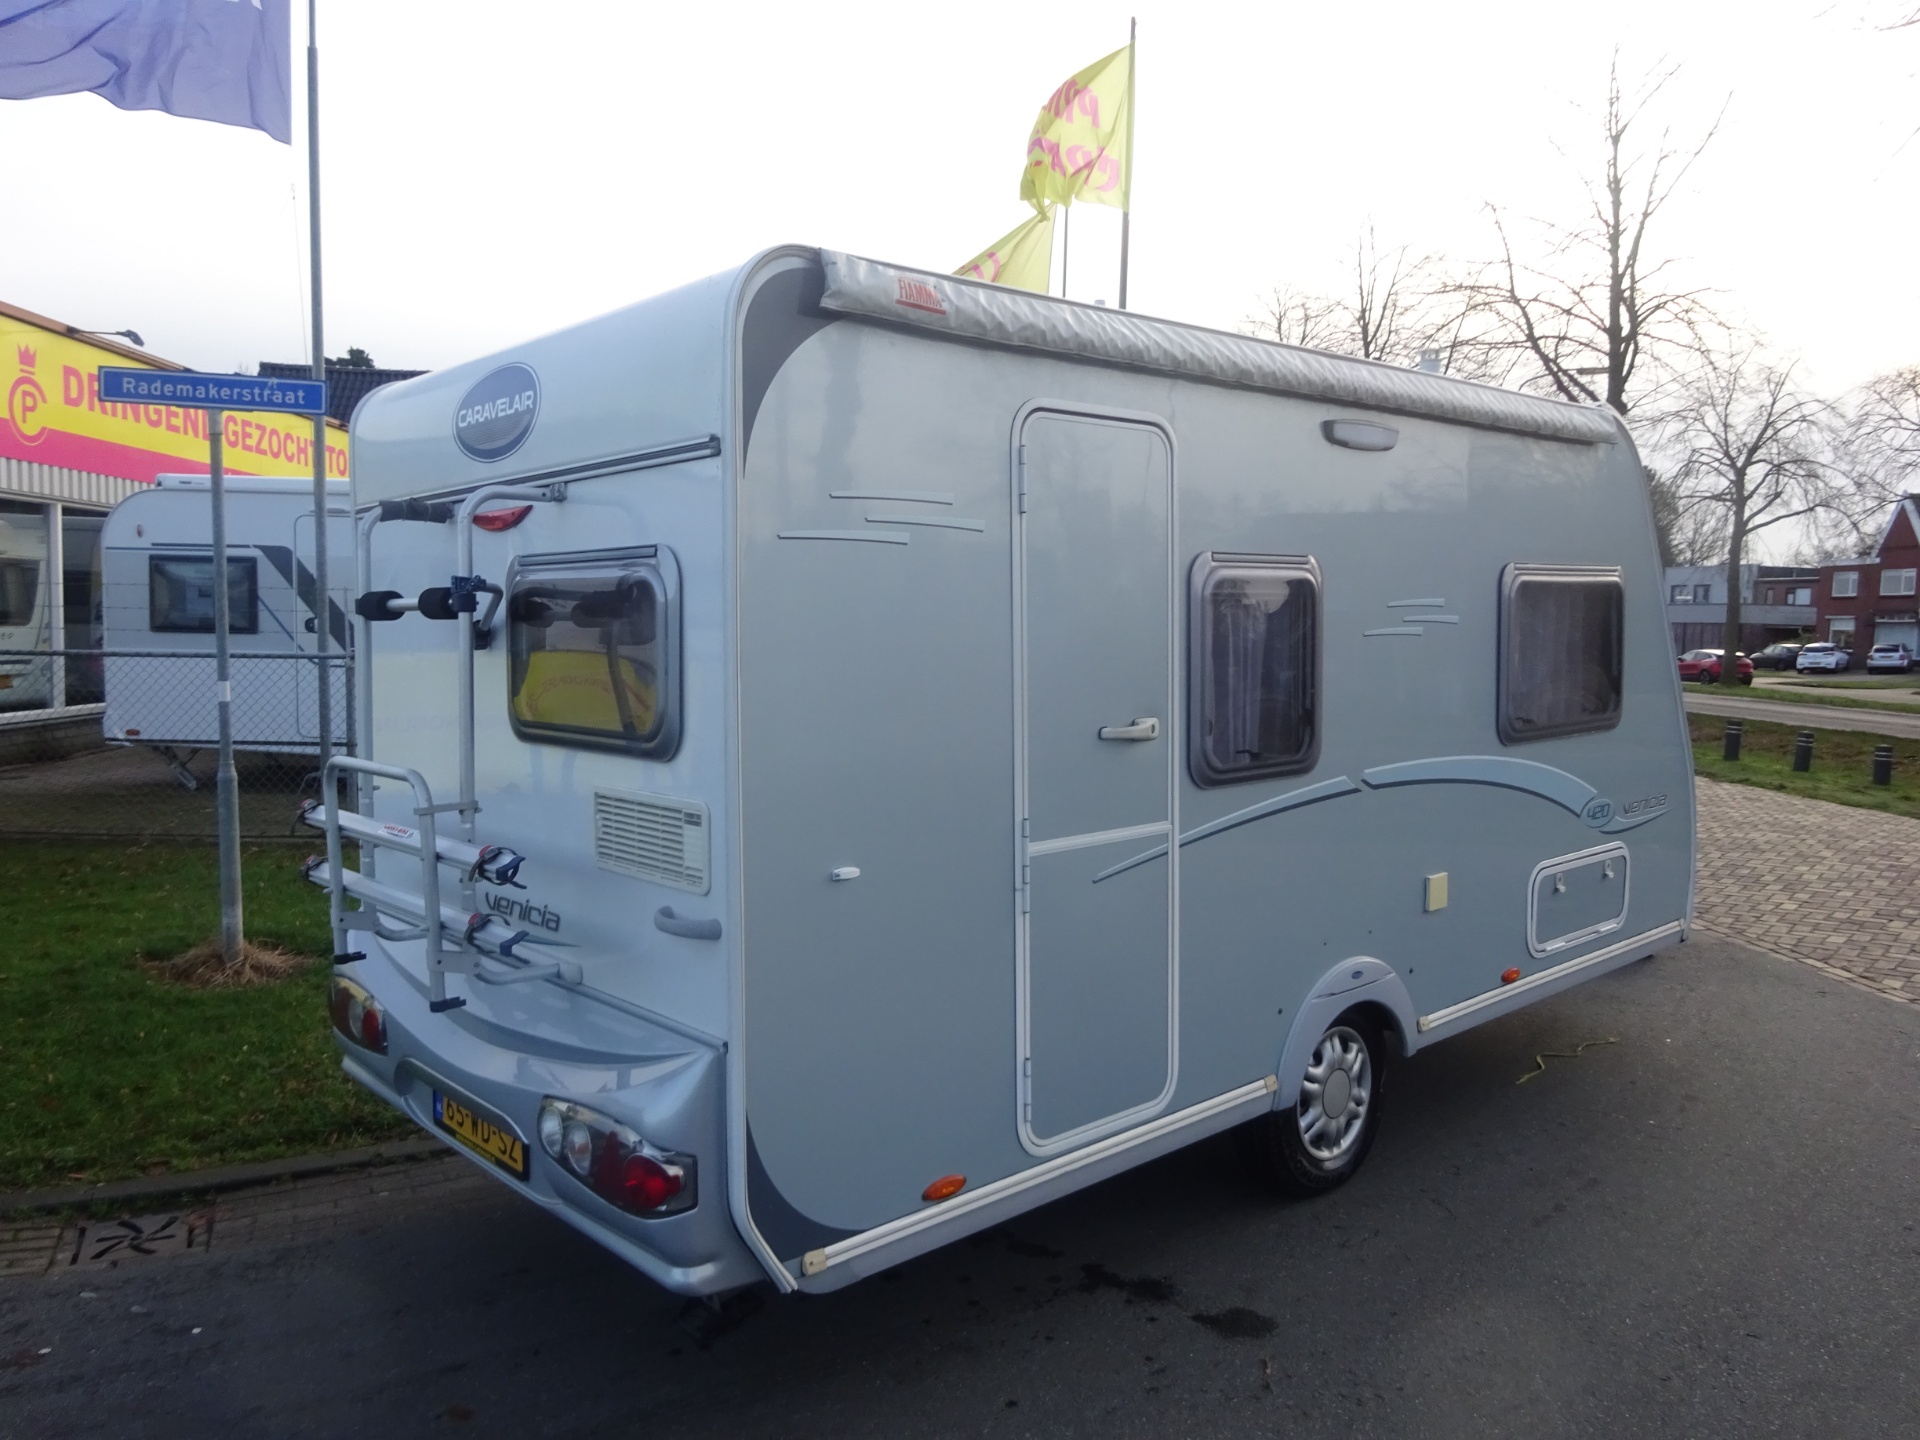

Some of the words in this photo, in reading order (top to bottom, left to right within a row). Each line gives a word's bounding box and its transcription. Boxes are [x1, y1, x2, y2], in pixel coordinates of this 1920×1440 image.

[122, 377, 305, 405] Rademakerstraat
[458, 390, 534, 428] CARAVELAIR
[1587, 803, 1611, 820] 420
[485, 891, 561, 933] venicia
